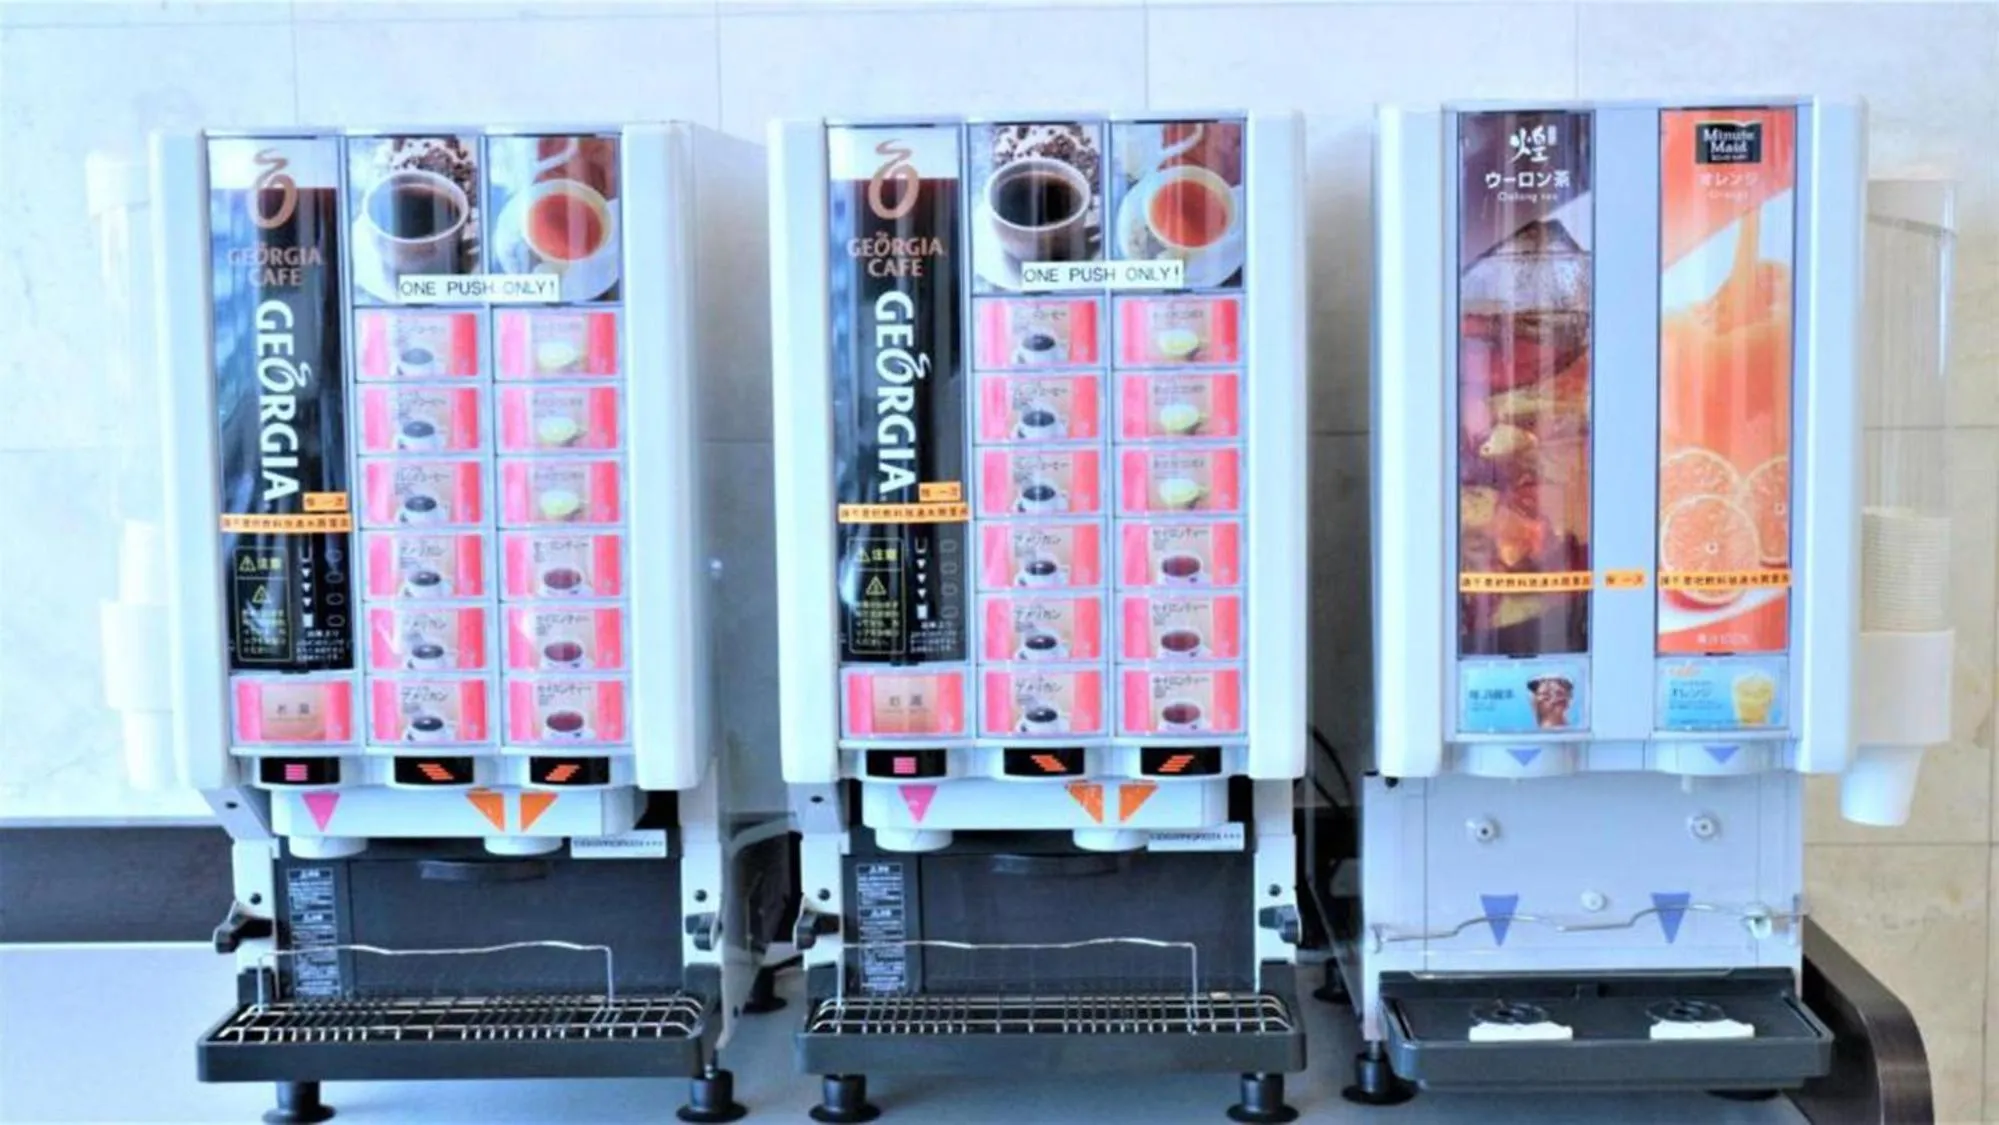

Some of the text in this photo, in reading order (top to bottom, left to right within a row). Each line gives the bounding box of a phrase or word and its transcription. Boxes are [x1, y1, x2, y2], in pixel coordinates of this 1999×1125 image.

[1703, 127, 1756, 142] Minute
[1711, 141, 1748, 153] Maid
[1485, 172, 1570, 189] ウーロン茶
[868, 258, 923, 277] CAFE
[1024, 265, 1179, 282] ONE PUSH ONLY!
[248, 267, 303, 287] CAFE
[400, 279, 555, 296] ONE PUSH ONLY!
[255, 299, 312, 501] GEORGIA
[874, 290, 932, 494] GEORGIA
